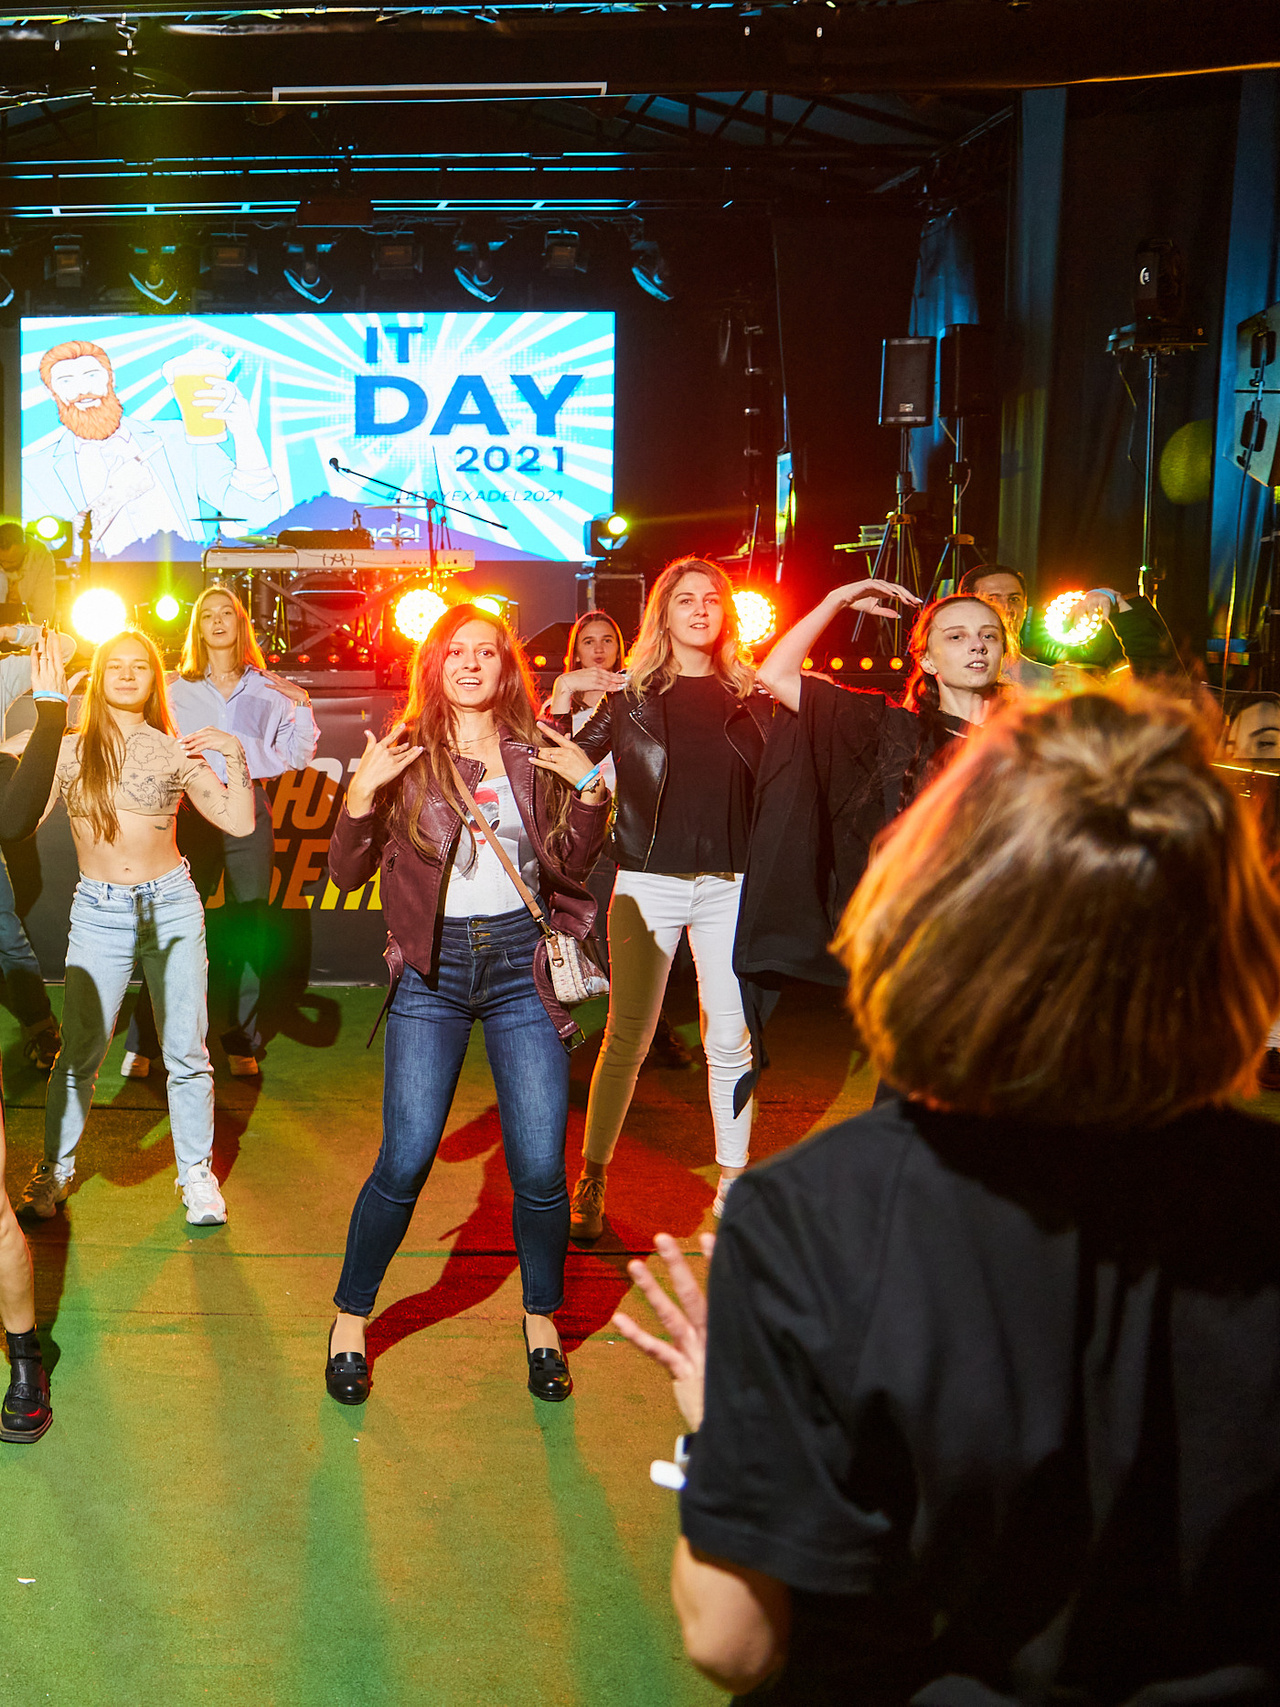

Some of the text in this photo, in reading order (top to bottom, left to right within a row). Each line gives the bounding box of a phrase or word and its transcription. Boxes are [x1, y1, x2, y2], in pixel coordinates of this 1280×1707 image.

[366, 326, 423, 364] IT
[354, 374, 583, 436] DAY
[455, 446, 566, 472] 2021
